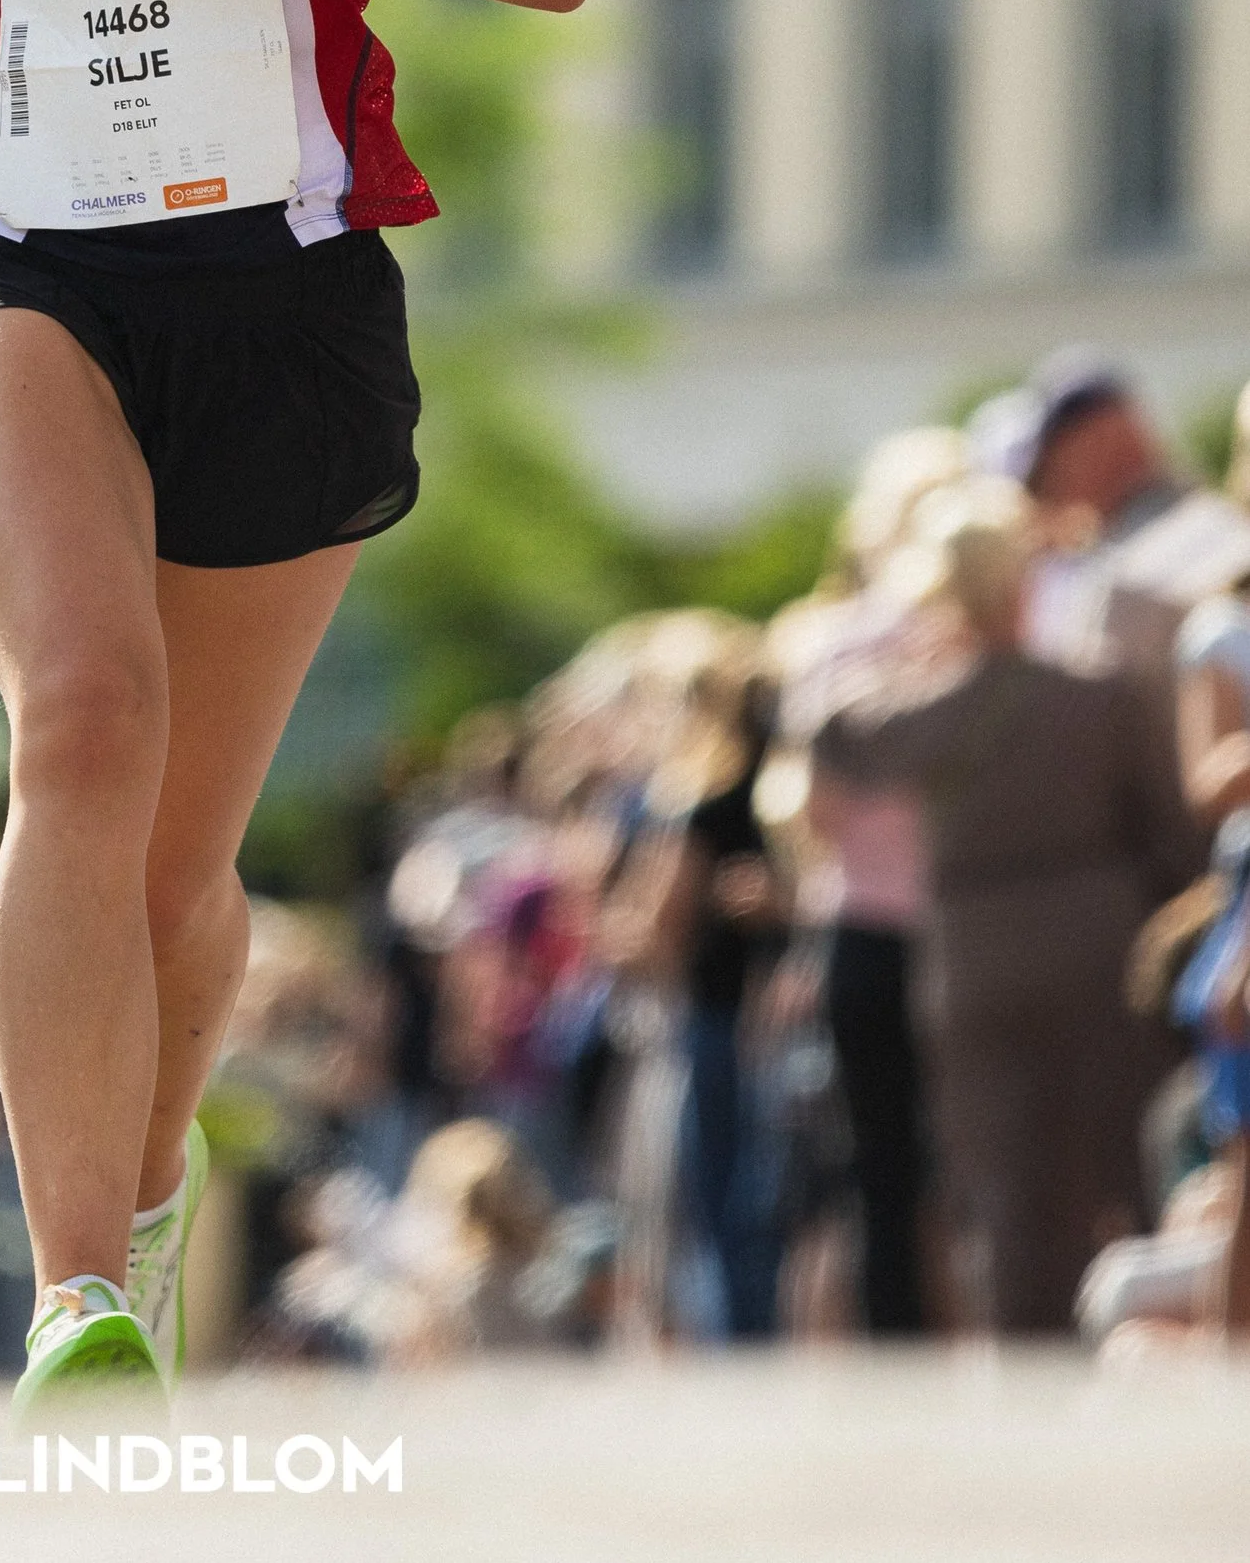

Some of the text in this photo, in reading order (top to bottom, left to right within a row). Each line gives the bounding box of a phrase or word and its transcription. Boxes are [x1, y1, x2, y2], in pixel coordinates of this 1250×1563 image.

[83, 0, 170, 39] 14468
[88, 48, 172, 87] SILJE
[114, 97, 151, 110] FET OL
[112, 117, 158, 133] D18 ELIT
[185, 184, 222, 196] O-RINGEN
[71, 192, 147, 211] CHALMERS
